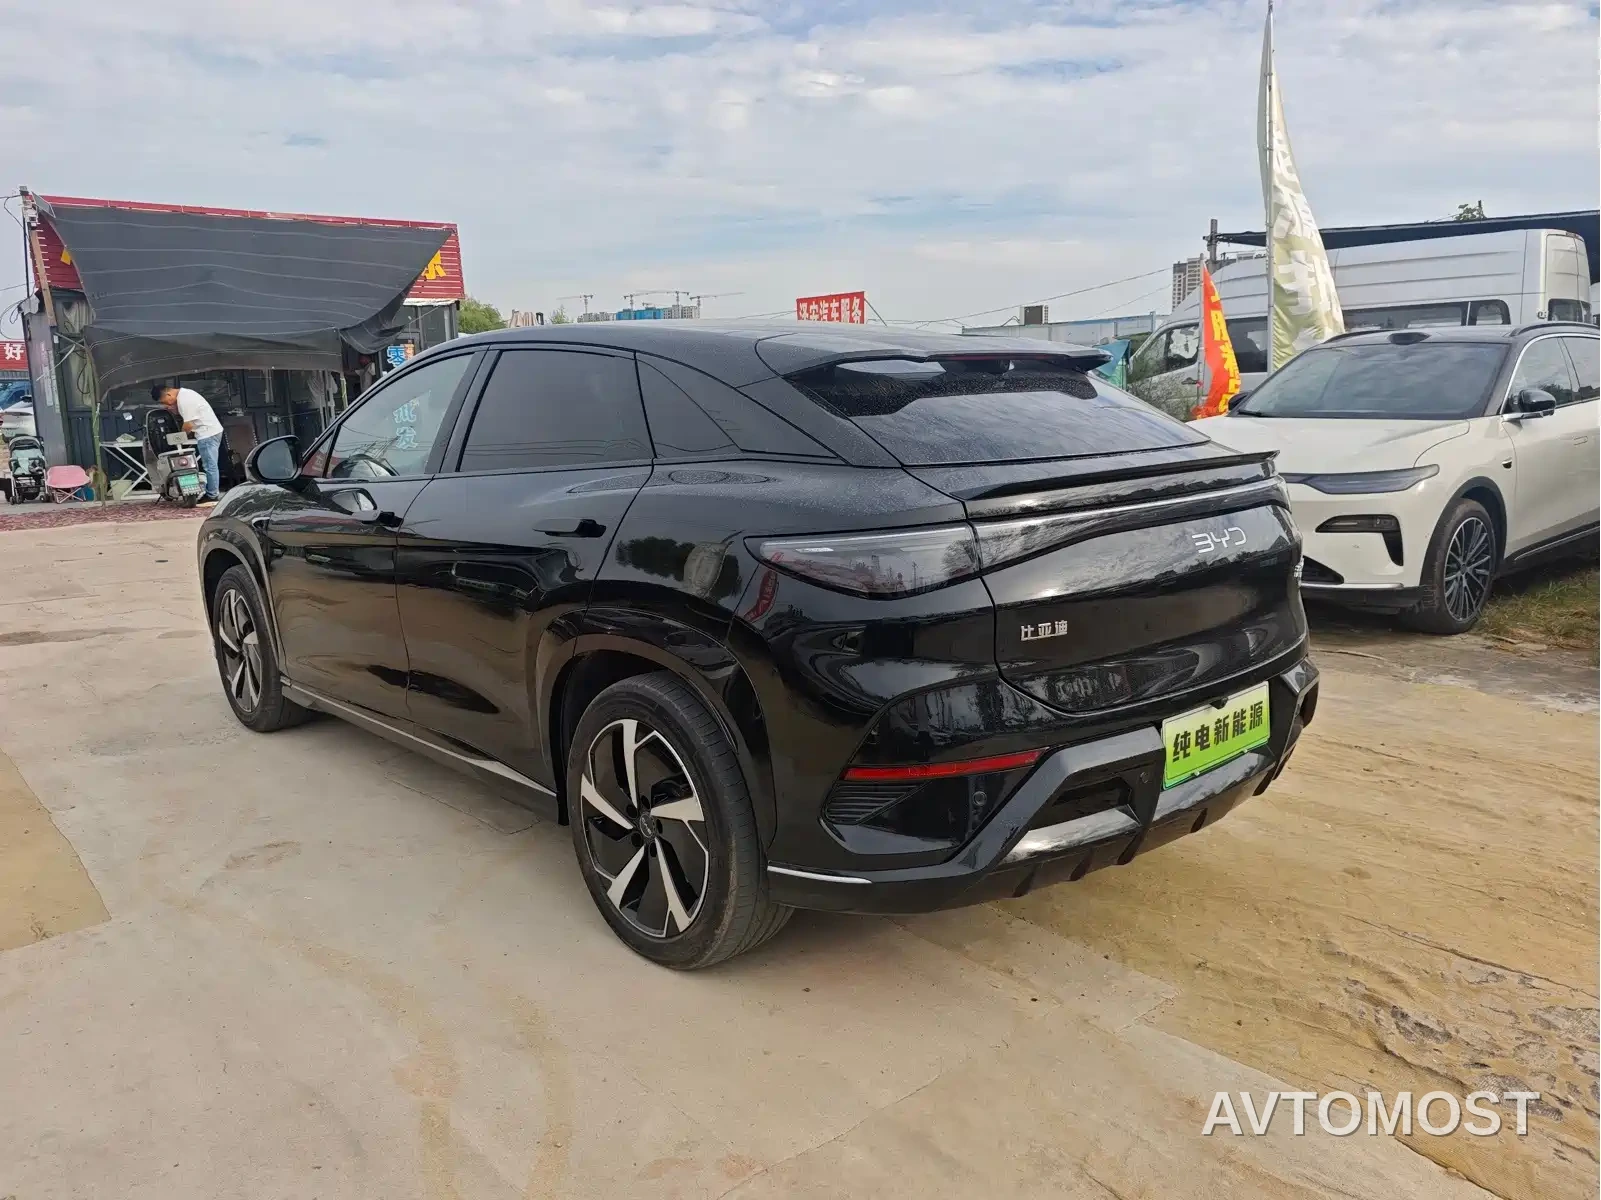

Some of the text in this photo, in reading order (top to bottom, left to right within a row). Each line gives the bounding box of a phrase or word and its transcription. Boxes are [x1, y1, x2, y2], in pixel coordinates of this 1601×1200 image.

[4, 343, 24, 360] 好
[1192, 527, 1247, 553] BYD
[1020, 620, 1068, 641] 比亚迪
[1173, 700, 1263, 762] 纯电新能源
